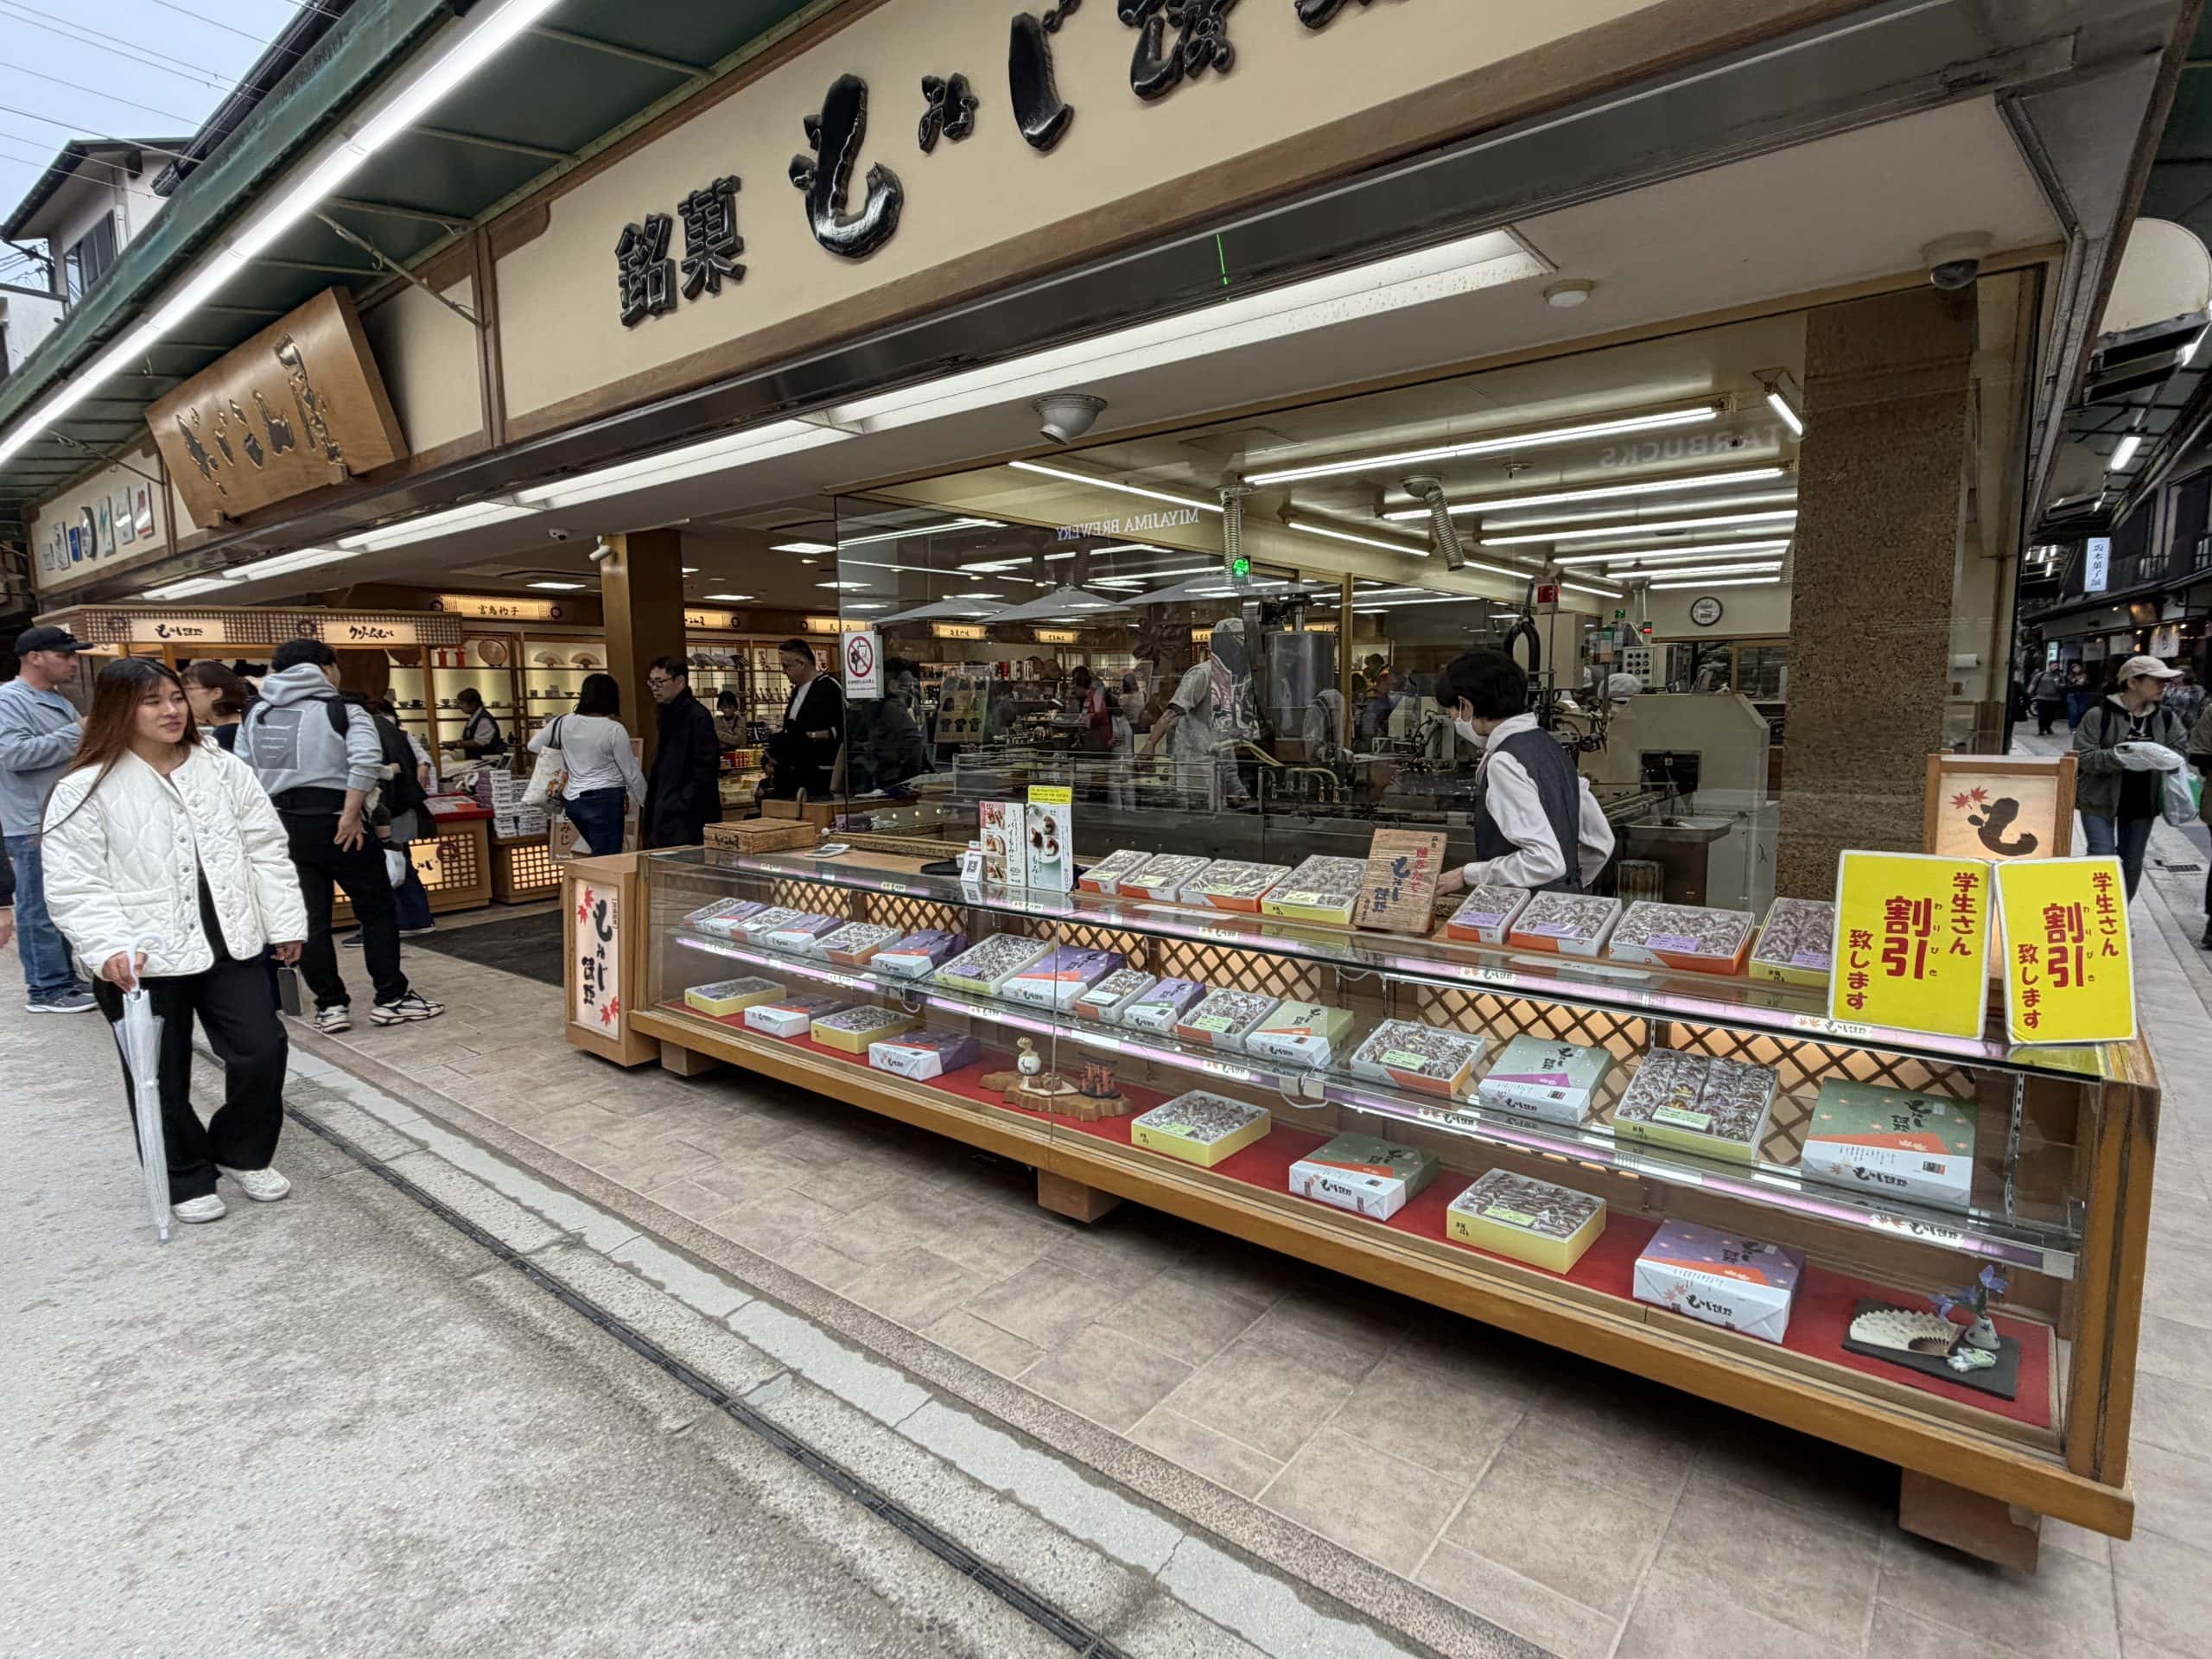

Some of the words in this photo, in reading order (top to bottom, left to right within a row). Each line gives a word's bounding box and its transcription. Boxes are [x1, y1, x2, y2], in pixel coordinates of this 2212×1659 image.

[615, 174, 747, 329] 銘菓
[593, 899, 613, 992] もみじ
[1881, 896, 1933, 981] 割引
[1929, 901, 1942, 977] わりびき
[1949, 872, 1980, 957] 学生さん
[2042, 901, 2085, 988] 割引
[2082, 906, 2094, 983] わりびき
[2093, 873, 2120, 957] 学生さん
[1846, 929, 1874, 1011] 致します
[2018, 944, 2042, 1031] 致します
